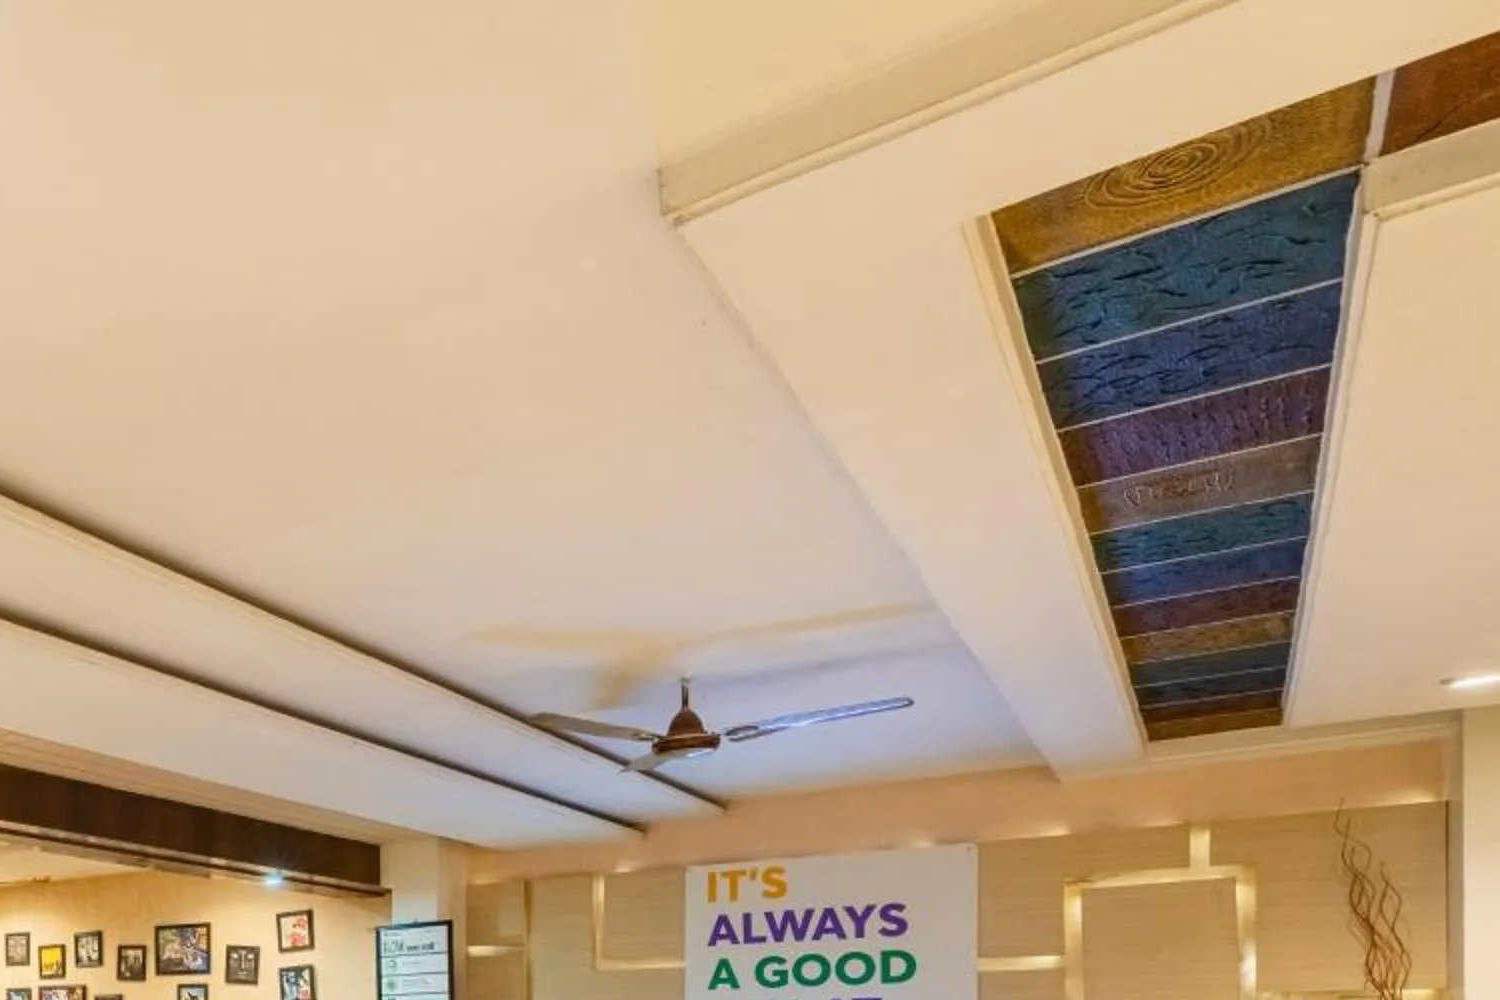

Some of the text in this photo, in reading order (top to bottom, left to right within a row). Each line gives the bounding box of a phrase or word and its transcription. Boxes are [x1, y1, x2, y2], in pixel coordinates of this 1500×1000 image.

[707, 866, 788, 902] IT'S
[707, 903, 909, 946] ALWAYS
[708, 950, 917, 990] A GOOD
